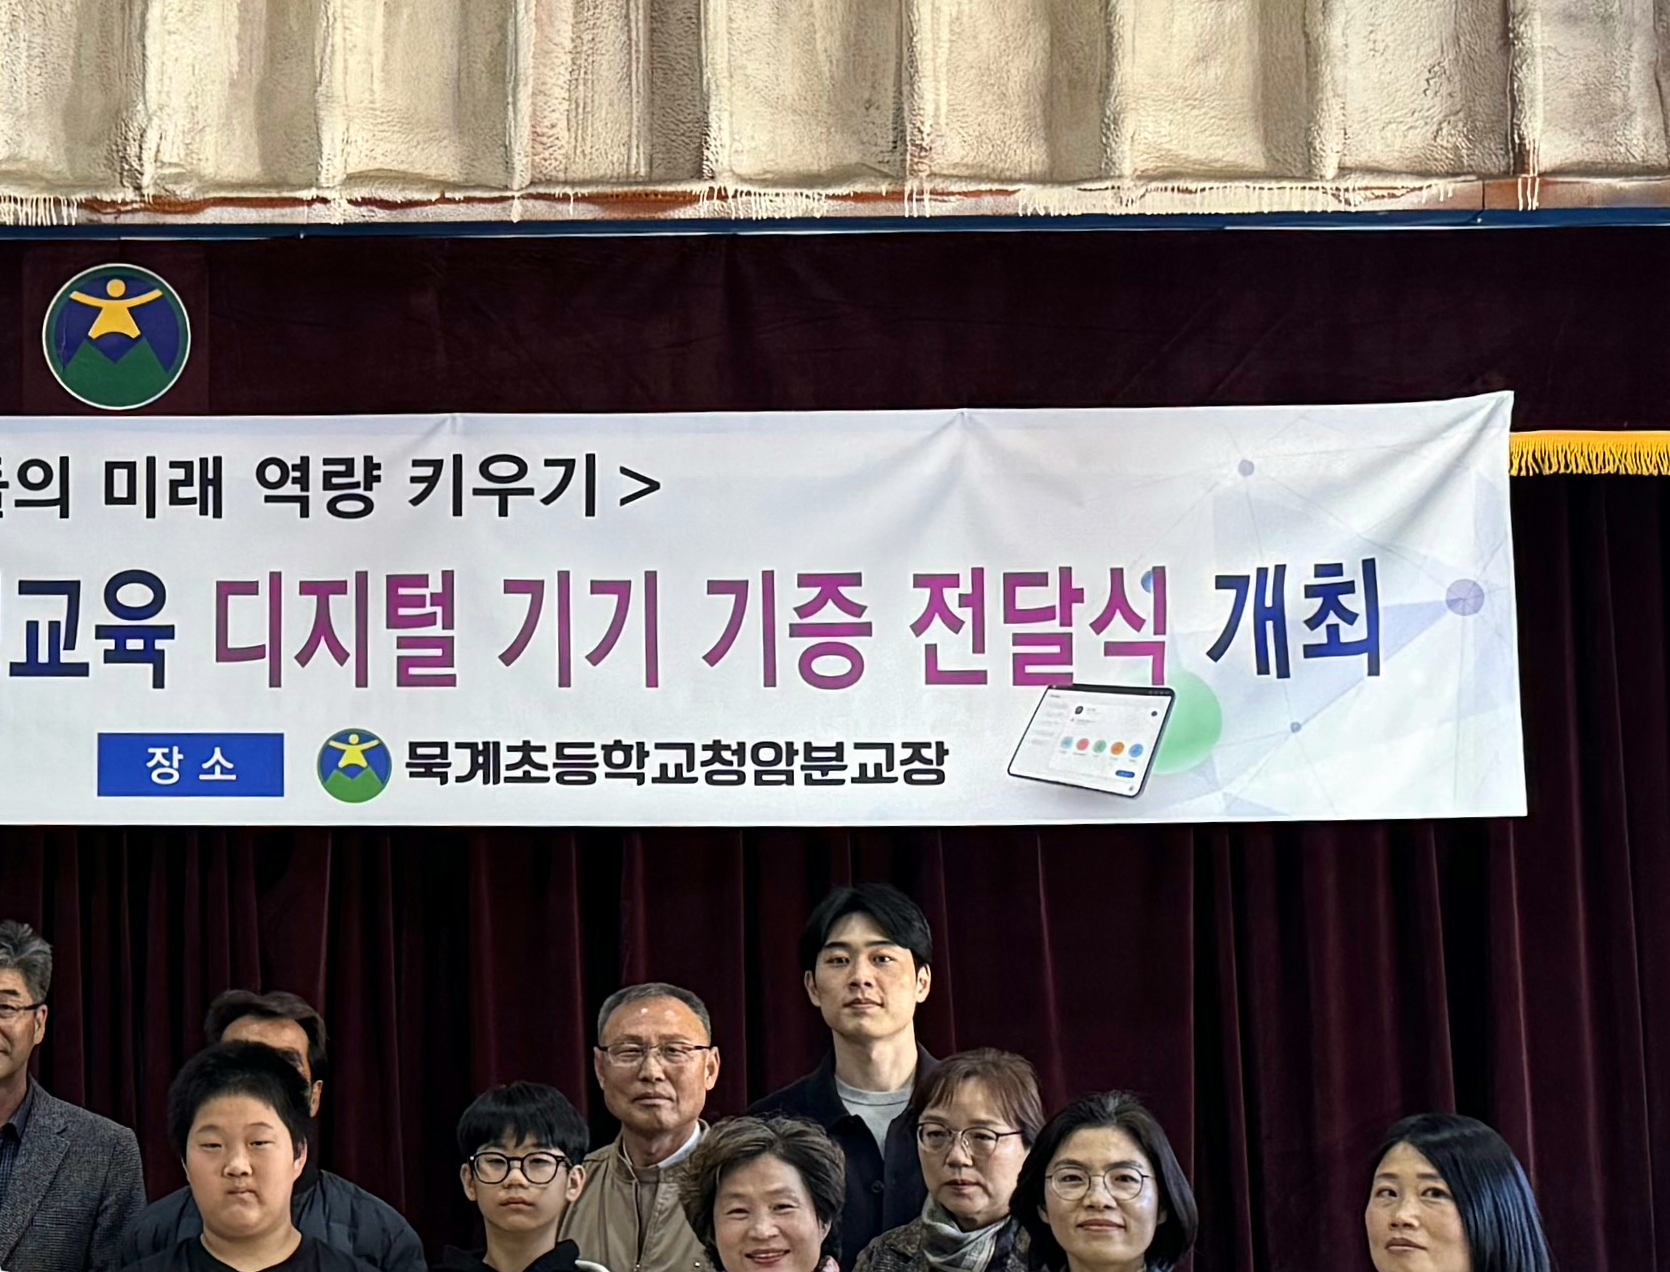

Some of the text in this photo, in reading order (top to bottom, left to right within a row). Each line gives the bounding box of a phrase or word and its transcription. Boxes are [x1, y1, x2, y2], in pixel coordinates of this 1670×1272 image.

[104, 455, 223, 519] 미래
[255, 455, 382, 520] 역량
[408, 453, 596, 518] 키우기
[215, 569, 457, 688] 디지털
[498, 570, 659, 688] 기기
[702, 569, 873, 690] 기증
[909, 565, 1167, 687] 전달식
[1205, 557, 1380, 680] 개최
[405, 739, 949, 786] 묵계초등학교청암분교장
